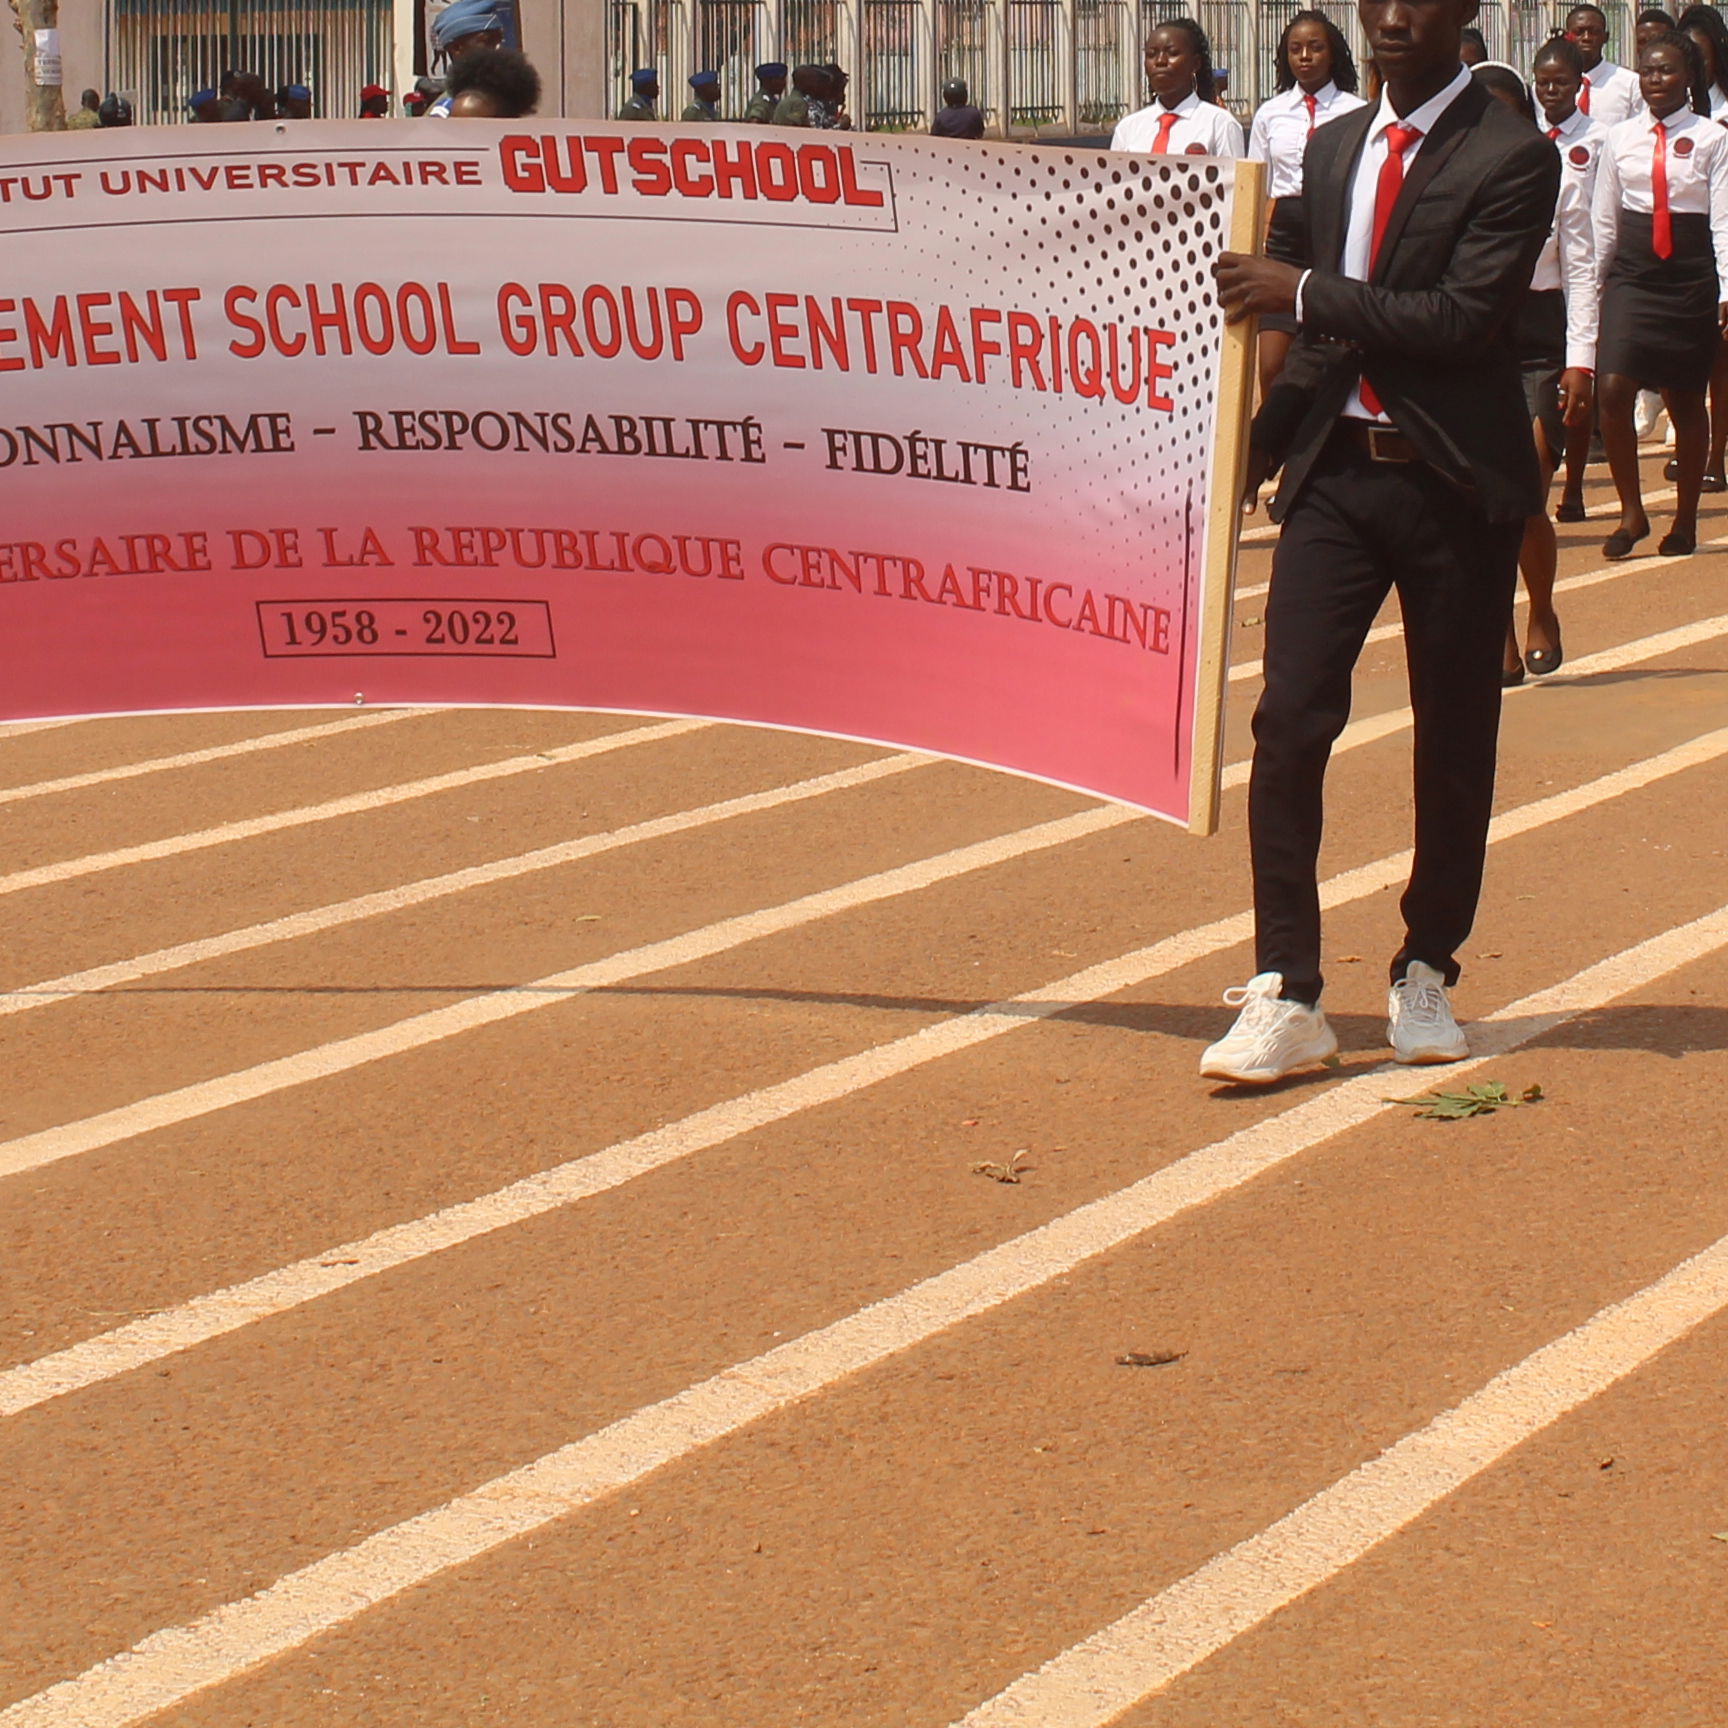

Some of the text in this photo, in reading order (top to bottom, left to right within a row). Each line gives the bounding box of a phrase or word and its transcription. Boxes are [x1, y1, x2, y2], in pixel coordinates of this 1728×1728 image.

[100, 159, 483, 197] UNIVERSITAIRE
[499, 133, 885, 208] GUTSCHOOL
[223, 281, 480, 360] SCHOOL
[496, 281, 705, 363] GROUP
[726, 289, 1178, 414] CENTRAFRIQUE
[354, 409, 767, 465] RESPONSABILITÉ
[822, 427, 1033, 494] FIDÉLITÉ
[226, 527, 305, 570] DE
[320, 525, 395, 568] LA
[408, 526, 746, 581] REPUBLIQUE
[761, 541, 1172, 656] CENTRAFRICAINE
[280, 608, 379, 648] 1958
[422, 608, 520, 648] 2022
